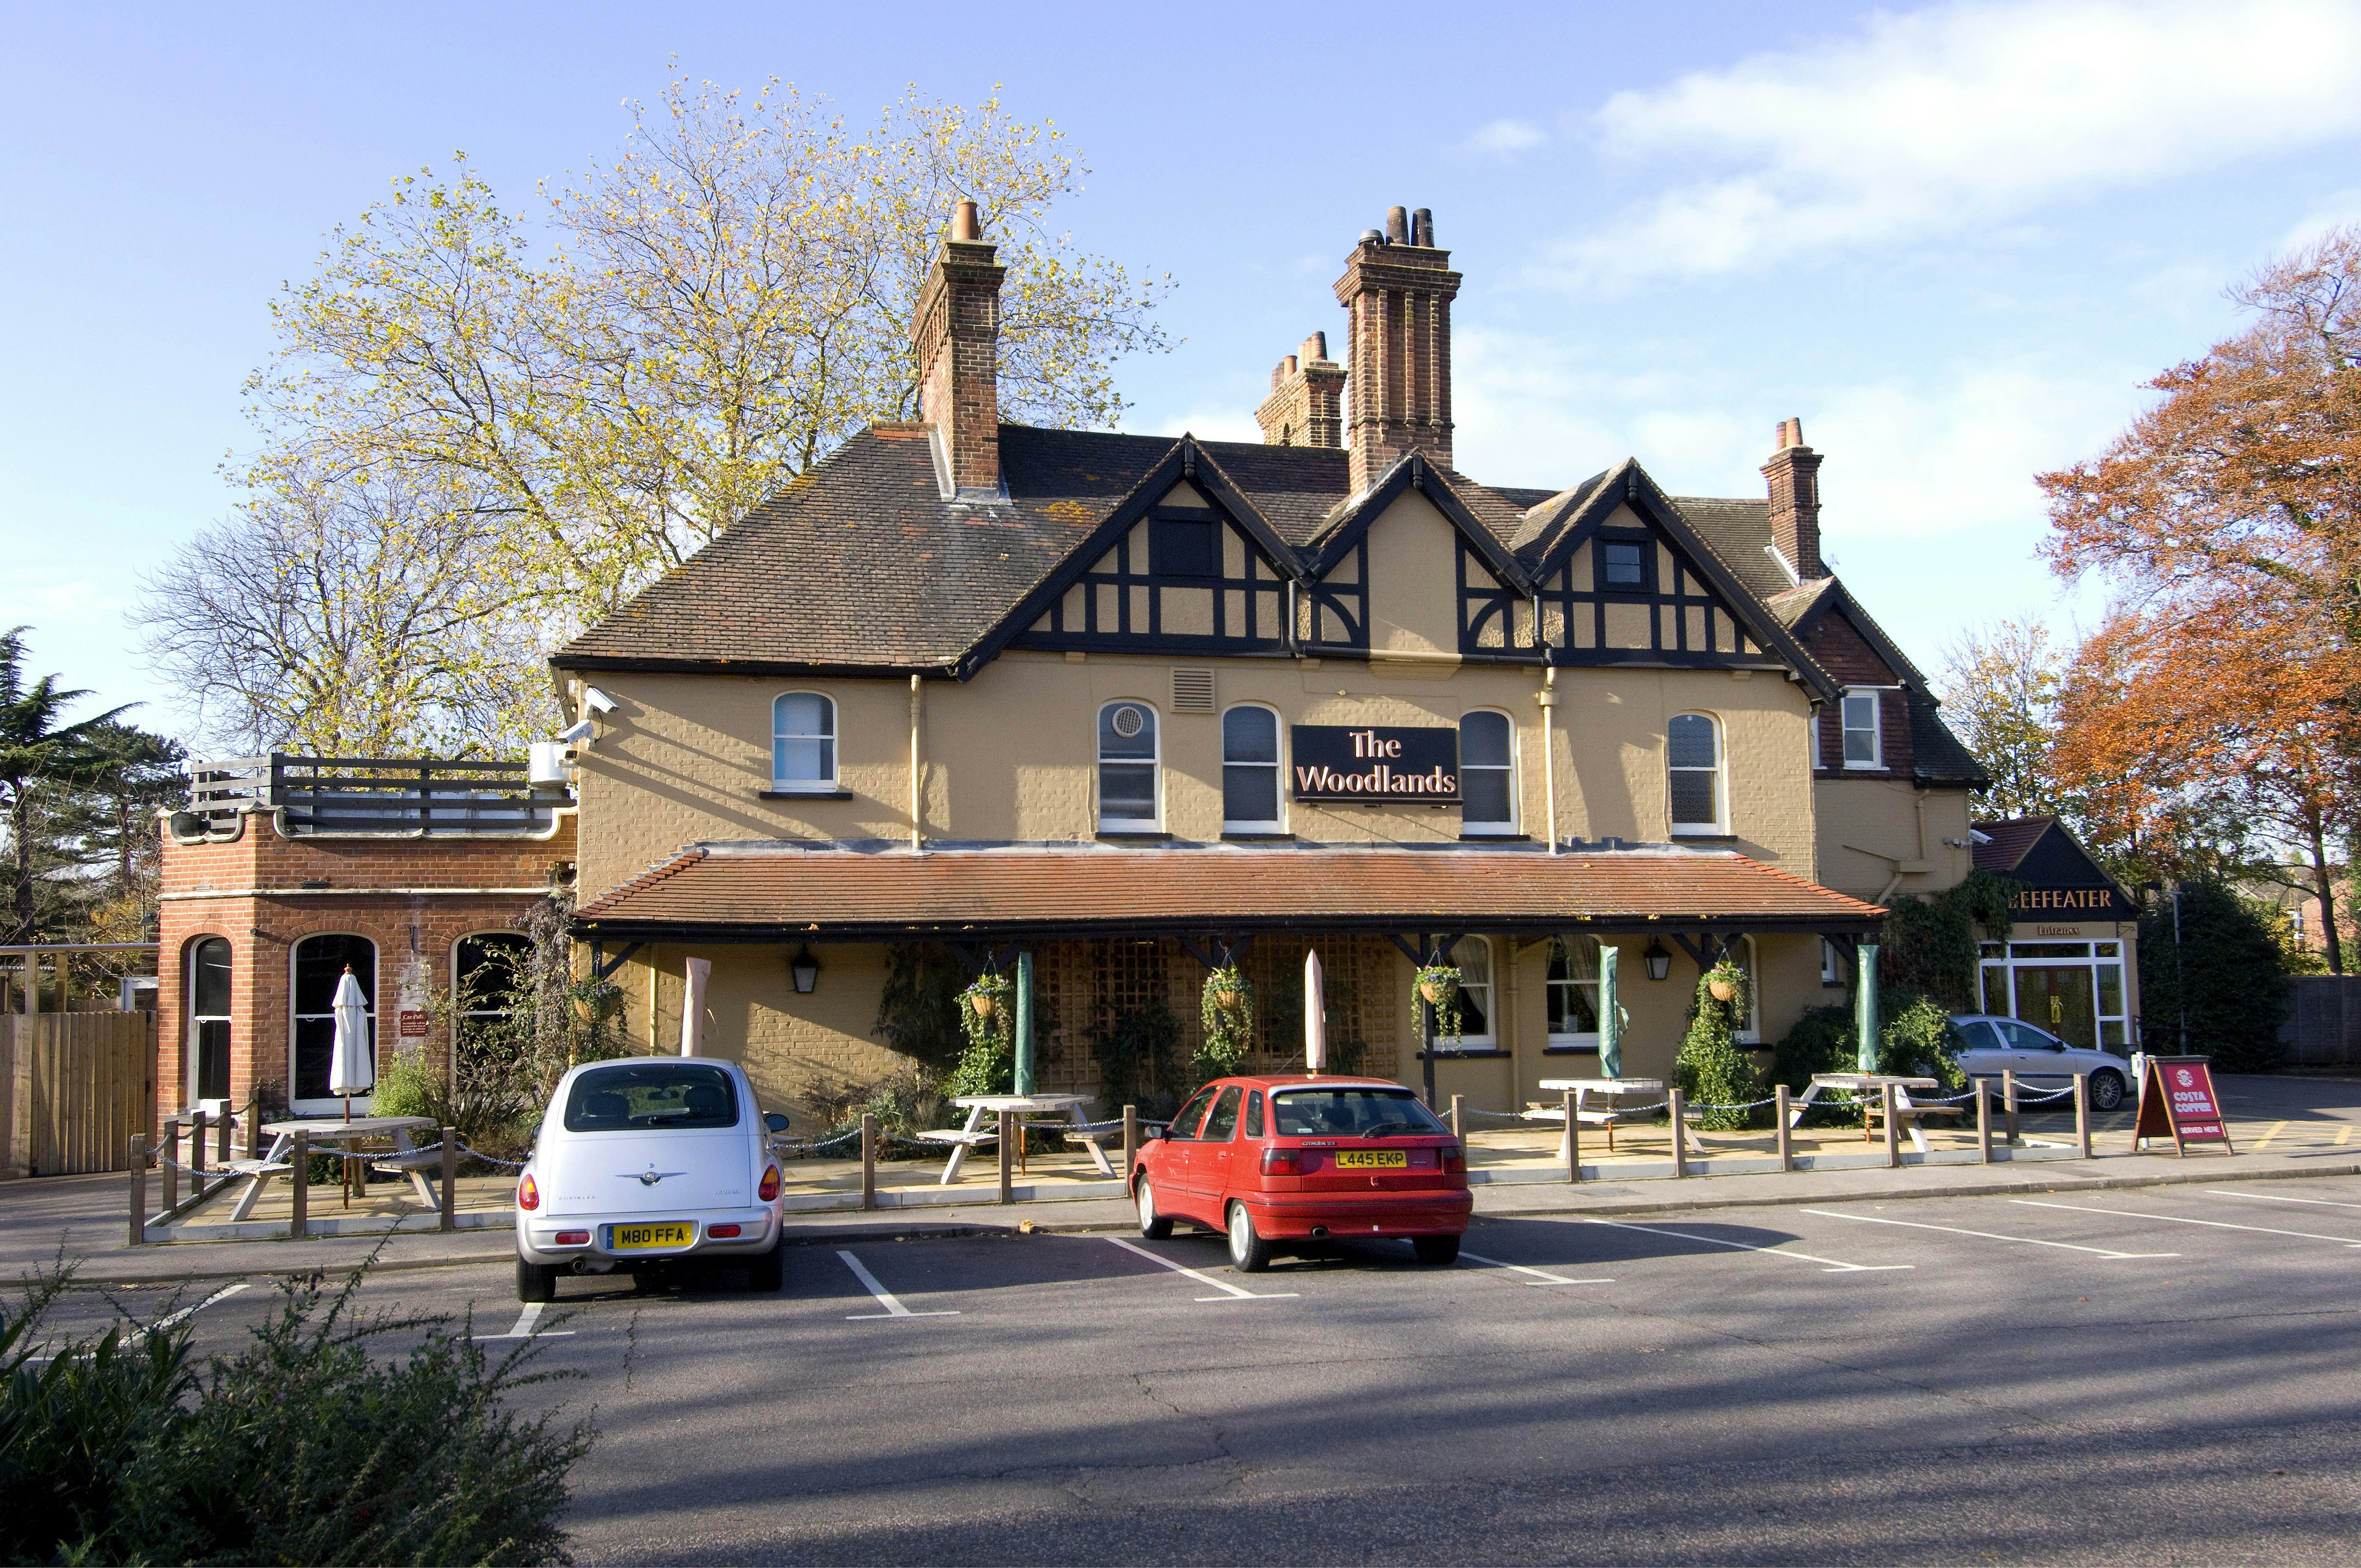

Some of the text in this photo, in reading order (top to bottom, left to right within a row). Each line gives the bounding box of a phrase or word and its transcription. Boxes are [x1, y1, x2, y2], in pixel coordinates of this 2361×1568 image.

[1349, 729, 1402, 758] The
[1296, 765, 1456, 793] Woodlands
[2038, 925, 2080, 935] Entrance
[2173, 1091, 2207, 1102] COSTA
[2175, 1102, 2212, 1112] COFFEE
[1337, 1152, 1403, 1166] L445 EKP
[622, 1228, 684, 1244] M80 FFA
